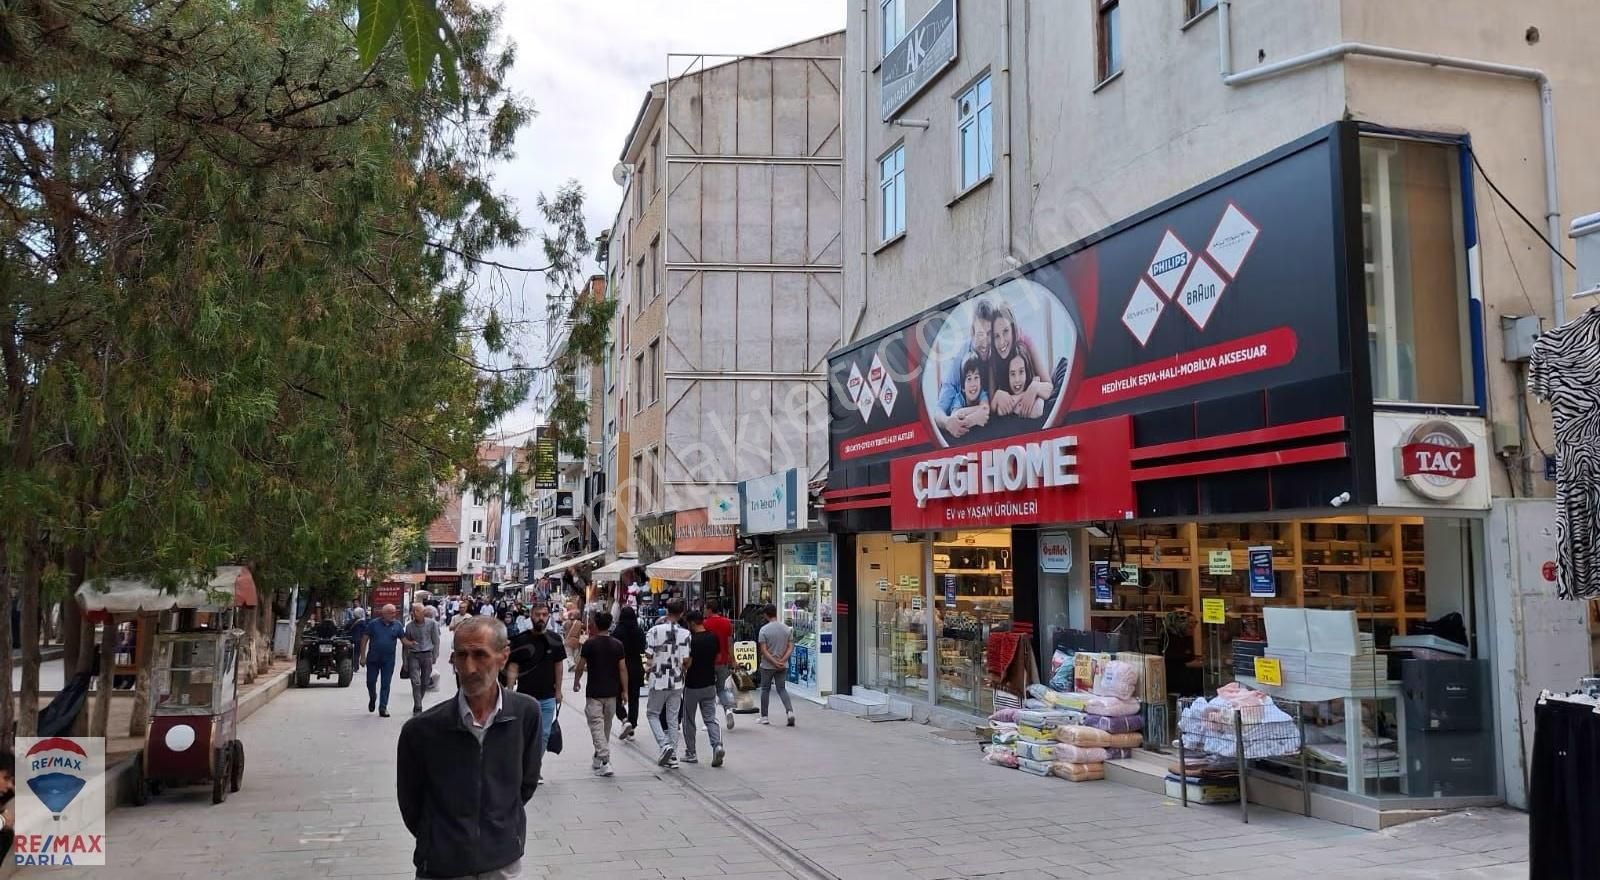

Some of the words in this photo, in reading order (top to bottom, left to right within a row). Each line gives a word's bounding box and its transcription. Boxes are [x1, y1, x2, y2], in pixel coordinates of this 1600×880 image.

[1153, 253, 1187, 275] PHILIPS
[1101, 376, 1138, 395] HEDİYELİK
[1218, 344, 1268, 367] AKSESUAR
[981, 435, 1080, 494] HOME
[1415, 451, 1462, 476] TAÇ
[946, 508, 956, 520] EV
[966, 505, 993, 520] YAŞAM
[994, 498, 1038, 517] ÜRÜNLERİ
[737, 653, 755, 661] CAM
